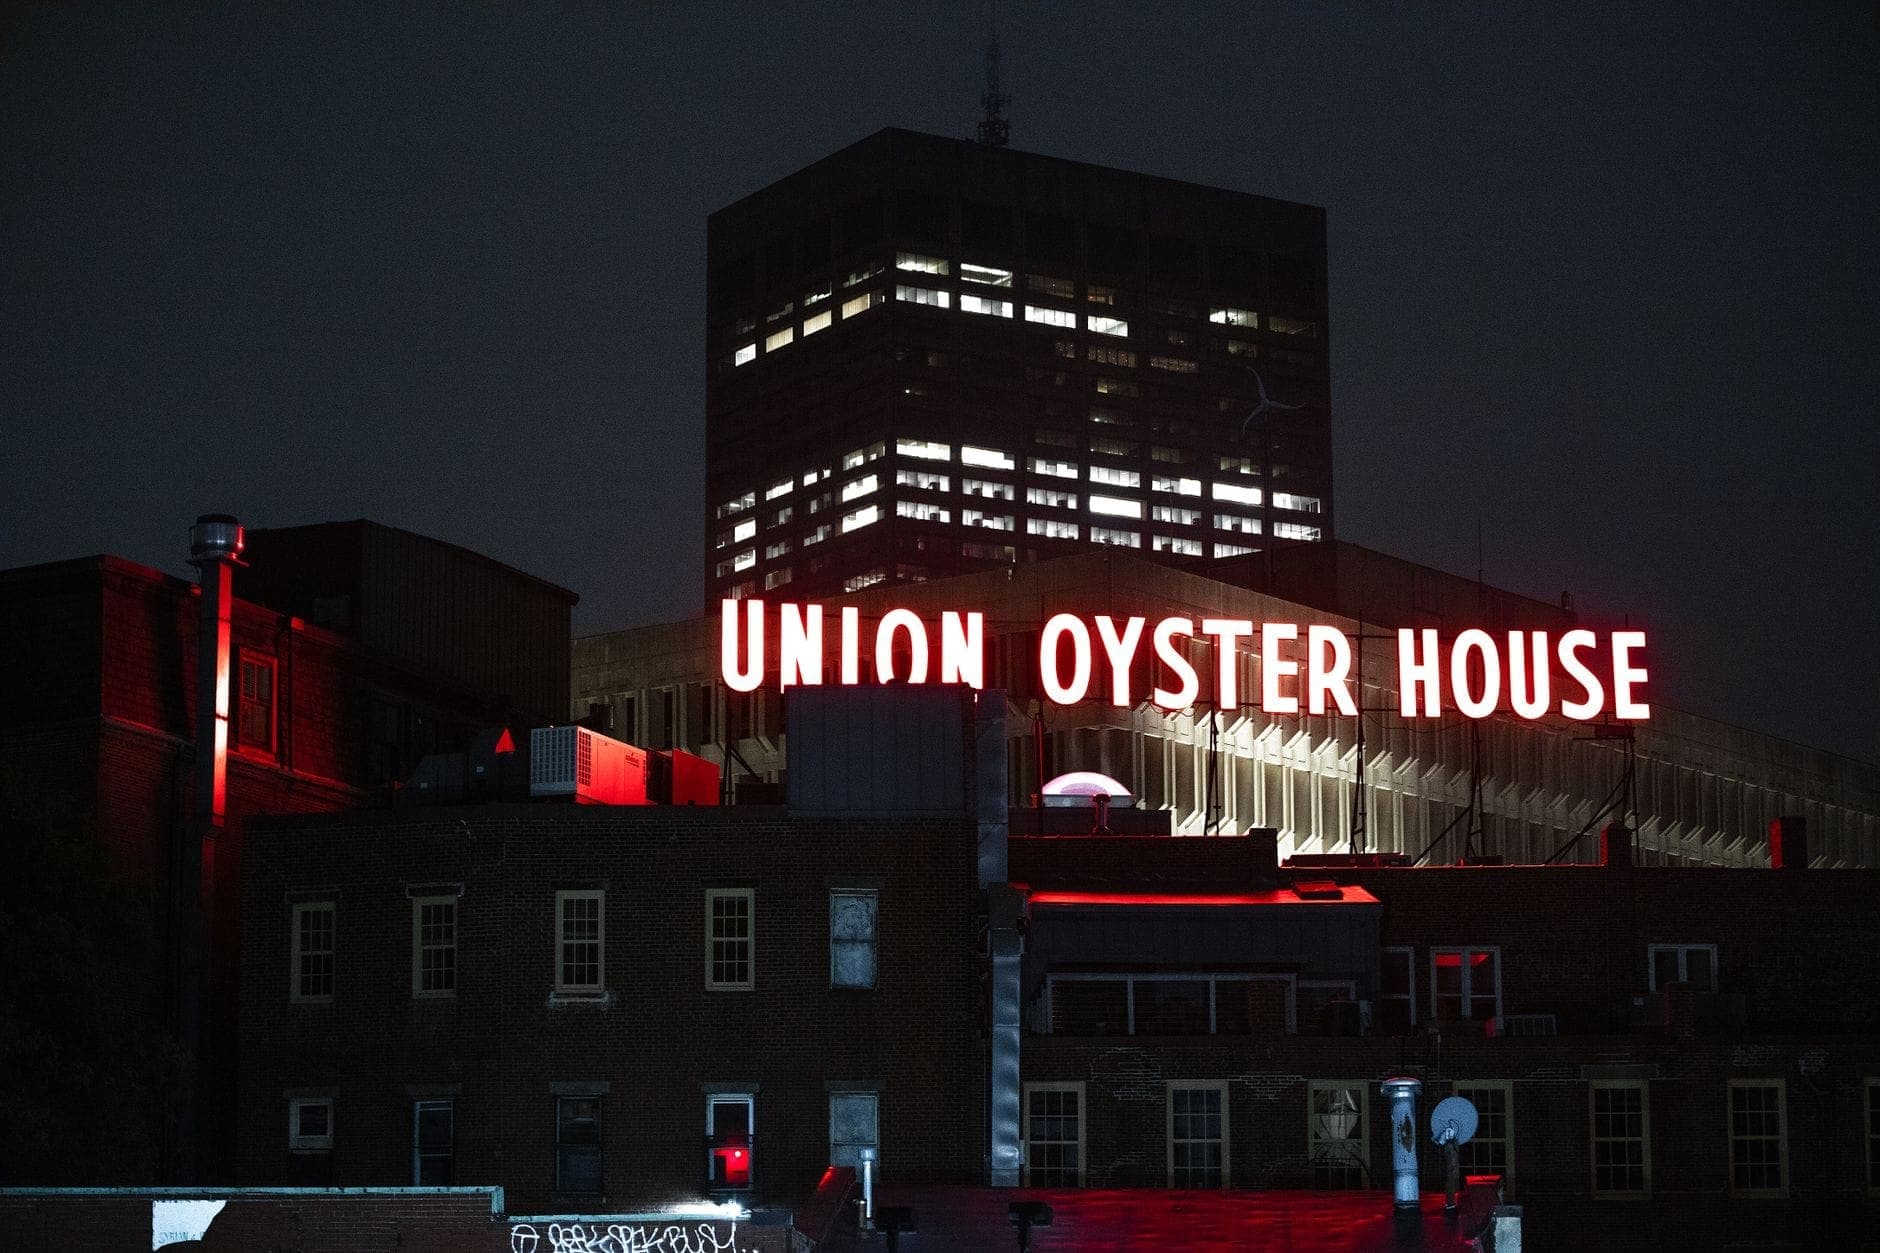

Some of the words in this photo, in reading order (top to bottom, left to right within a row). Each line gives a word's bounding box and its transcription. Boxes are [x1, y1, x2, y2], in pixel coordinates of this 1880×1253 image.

[720, 597, 984, 695] UNION
[1039, 612, 1360, 717] OYSTER
[1397, 627, 1652, 721] HOUSE
